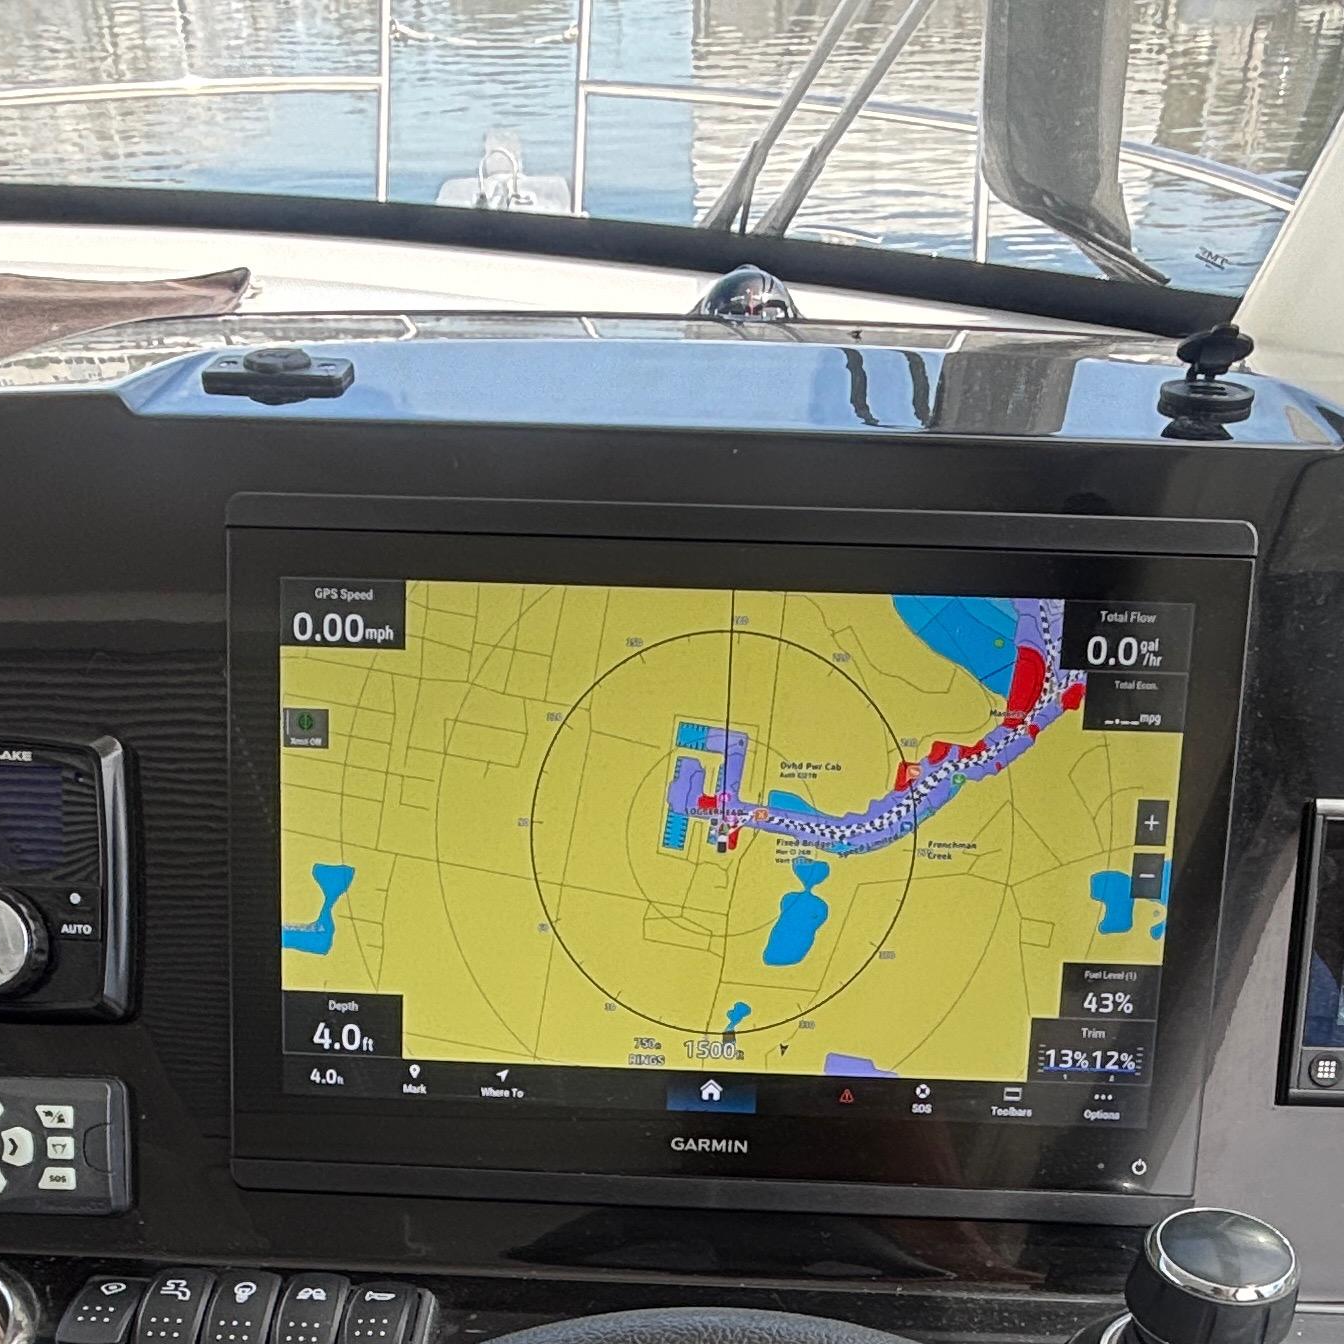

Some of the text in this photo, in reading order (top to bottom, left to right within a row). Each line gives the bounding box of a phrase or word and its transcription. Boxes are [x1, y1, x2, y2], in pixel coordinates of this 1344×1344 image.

[314, 587, 374, 602] GPS Speed
[1100, 610, 1157, 624] Total Flow
[1087, 635, 1138, 667] 0.0
[1140, 638, 1160, 655] gal
[1142, 653, 1163, 667] /hr
[1139, 713, 1162, 726] mpg
[824, 763, 842, 772] Cab
[61, 923, 92, 936] AUTO
[1084, 970, 1102, 979] Fuel
[328, 1000, 359, 1014] Depth
[1083, 991, 1134, 1014] 43%
[1081, 1027, 1106, 1039] Trim
[628, 1053, 666, 1066] RINGS
[1045, 1048, 1136, 1070] 13% 12%
[402, 1083, 427, 1095] Mark
[480, 1086, 525, 1099] Where To
[911, 1103, 932, 1115] SOS
[991, 1106, 1033, 1118] Toolbars
[1083, 1108, 1121, 1121] Options
[670, 1136, 749, 1154] GARMIN
[48, 1174, 67, 1184] SOS
